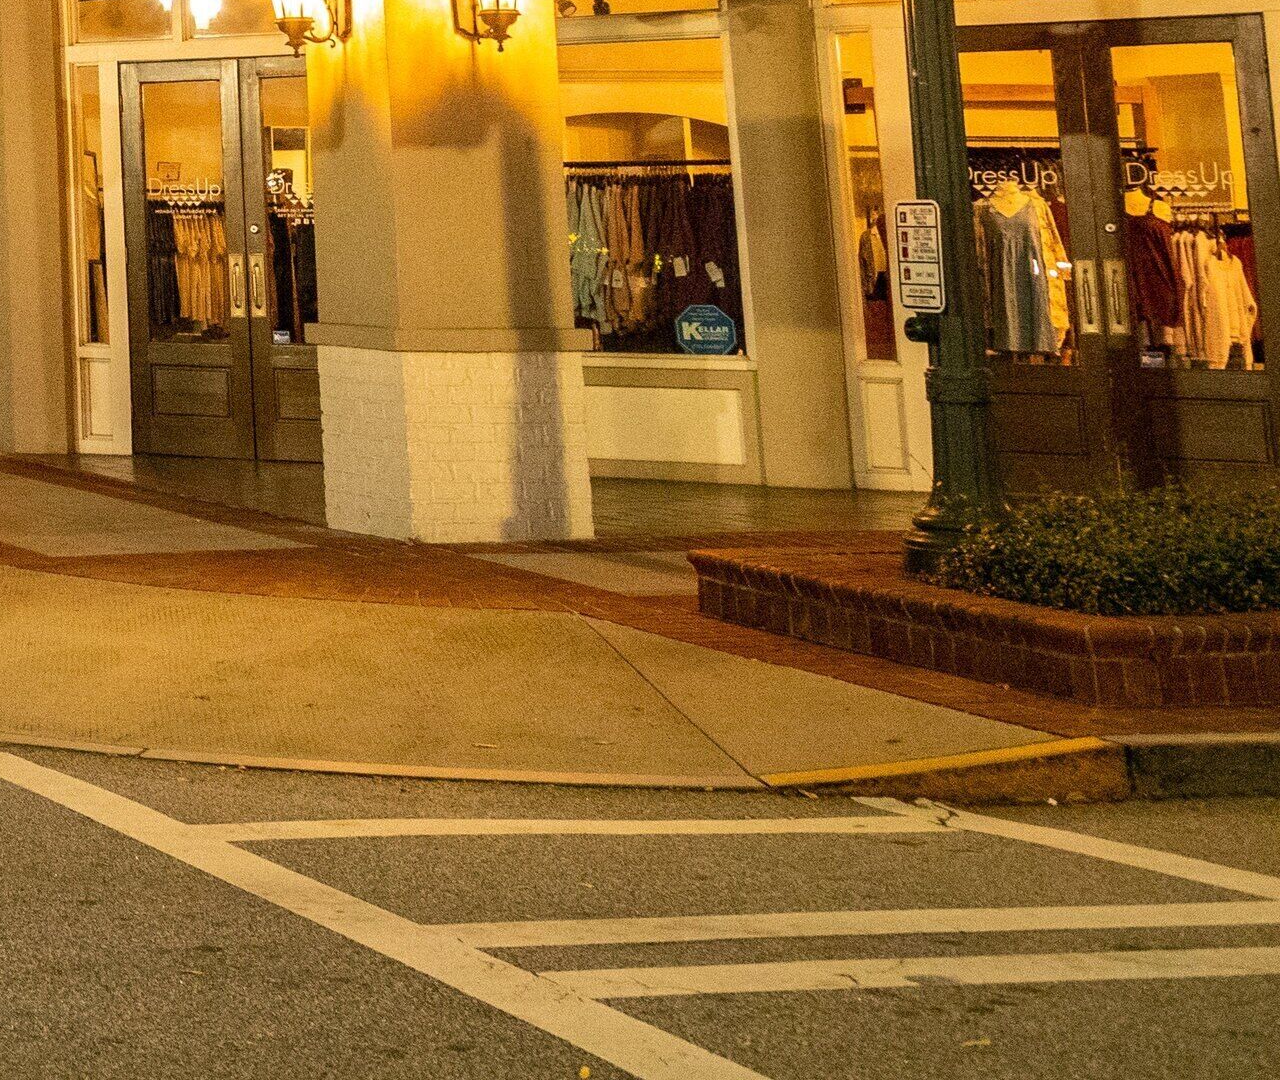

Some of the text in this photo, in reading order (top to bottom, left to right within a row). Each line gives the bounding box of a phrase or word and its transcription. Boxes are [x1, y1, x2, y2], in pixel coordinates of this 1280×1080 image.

[1126, 162, 1235, 190] DressUp
[148, 177, 221, 201] DressUp
[681, 321, 729, 341] KELLAR
